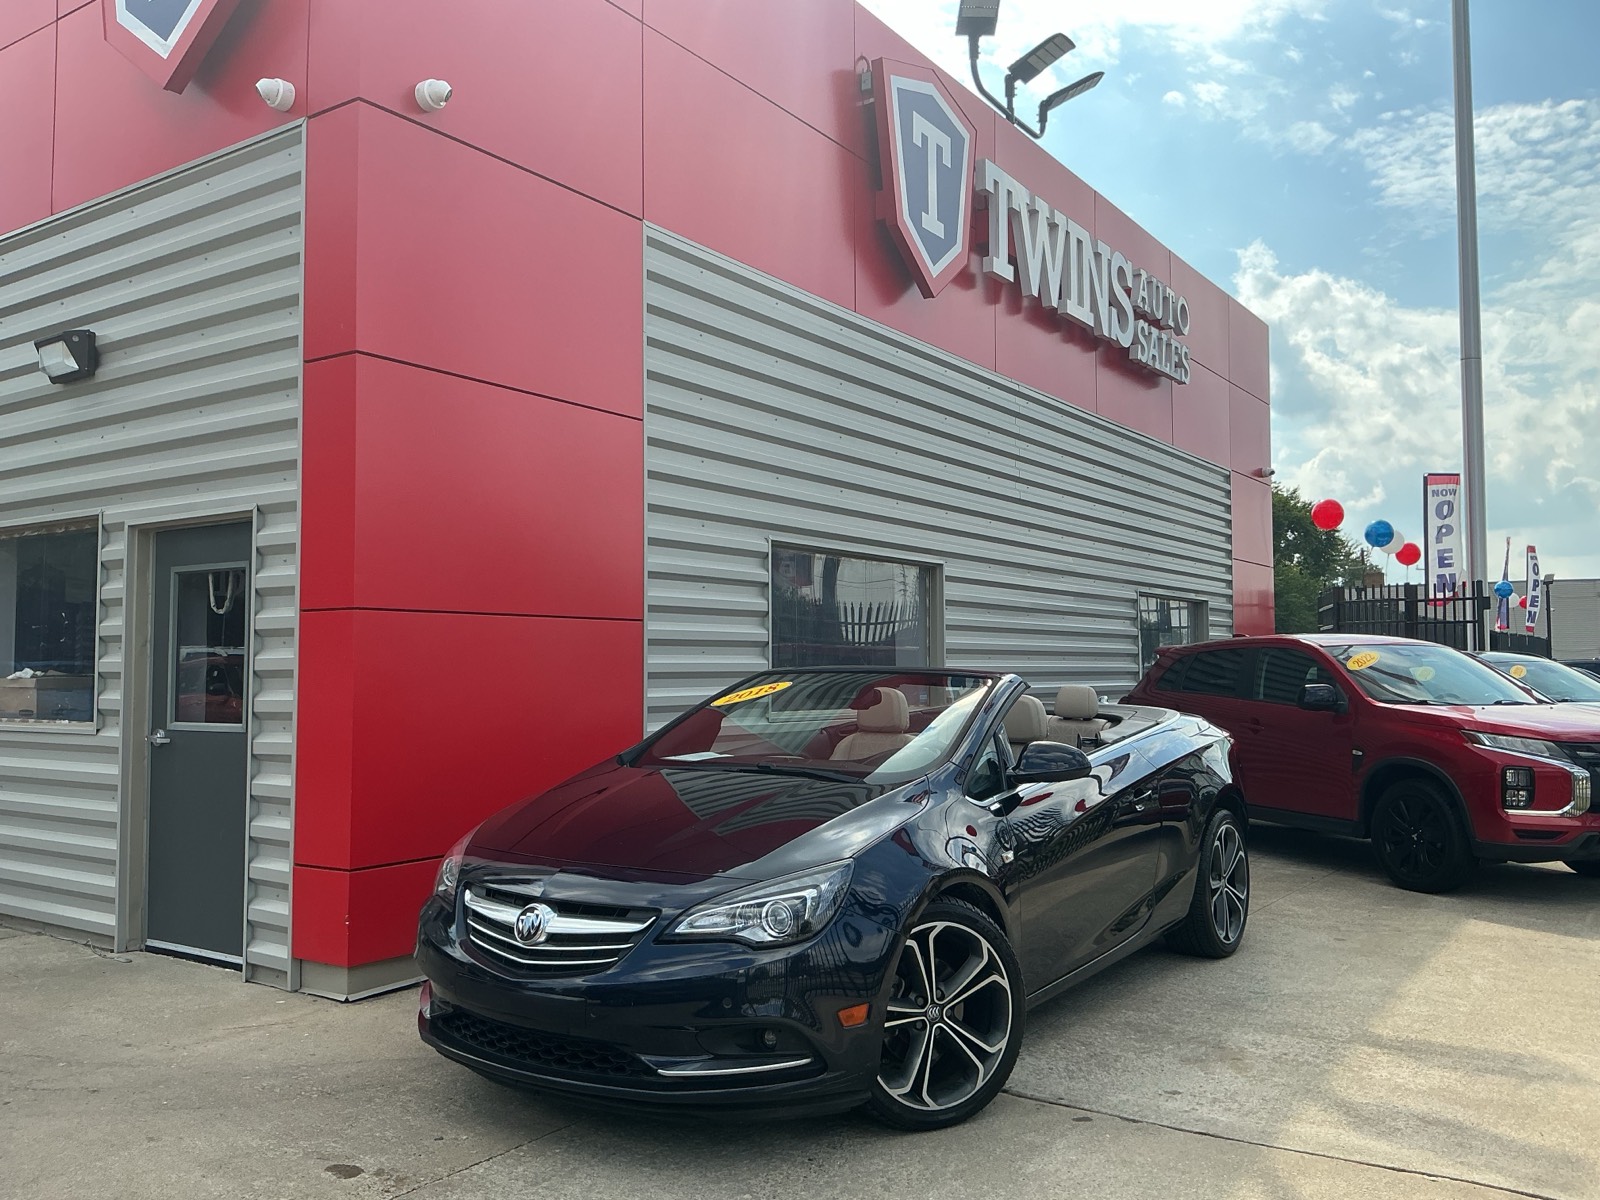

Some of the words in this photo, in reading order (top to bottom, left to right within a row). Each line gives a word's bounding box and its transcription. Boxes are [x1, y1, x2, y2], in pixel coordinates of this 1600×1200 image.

[912, 110, 952, 240] T
[975, 158, 1135, 349] TWINS
[1133, 268, 1190, 337] AUTO
[1130, 320, 1191, 386] SALES
[1431, 488, 1457, 498] NOW
[1435, 499, 1457, 594] OPEN
[1526, 562, 1540, 624] OPEN
[724, 683, 780, 703] 2018
